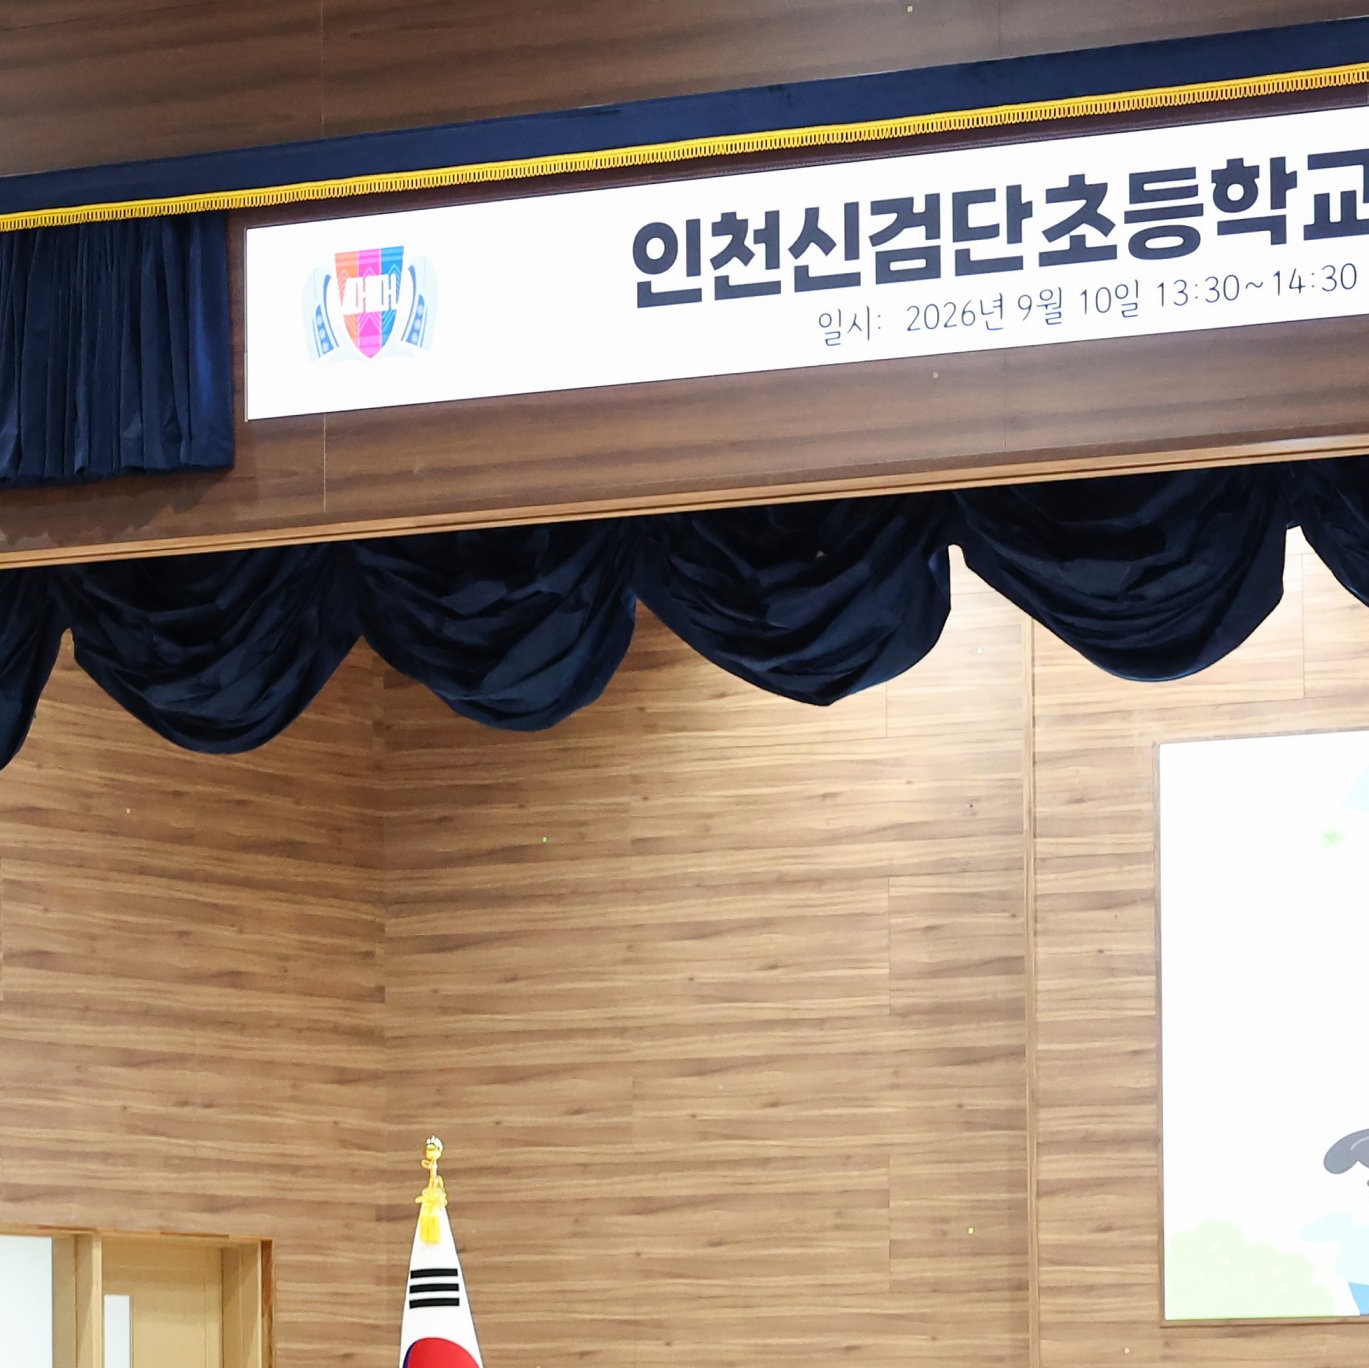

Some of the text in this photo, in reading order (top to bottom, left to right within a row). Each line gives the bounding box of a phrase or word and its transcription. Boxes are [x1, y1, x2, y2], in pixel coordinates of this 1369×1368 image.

[817, 262, 1359, 347] 일시: 2026년 9월 10일 13:30~14:30
